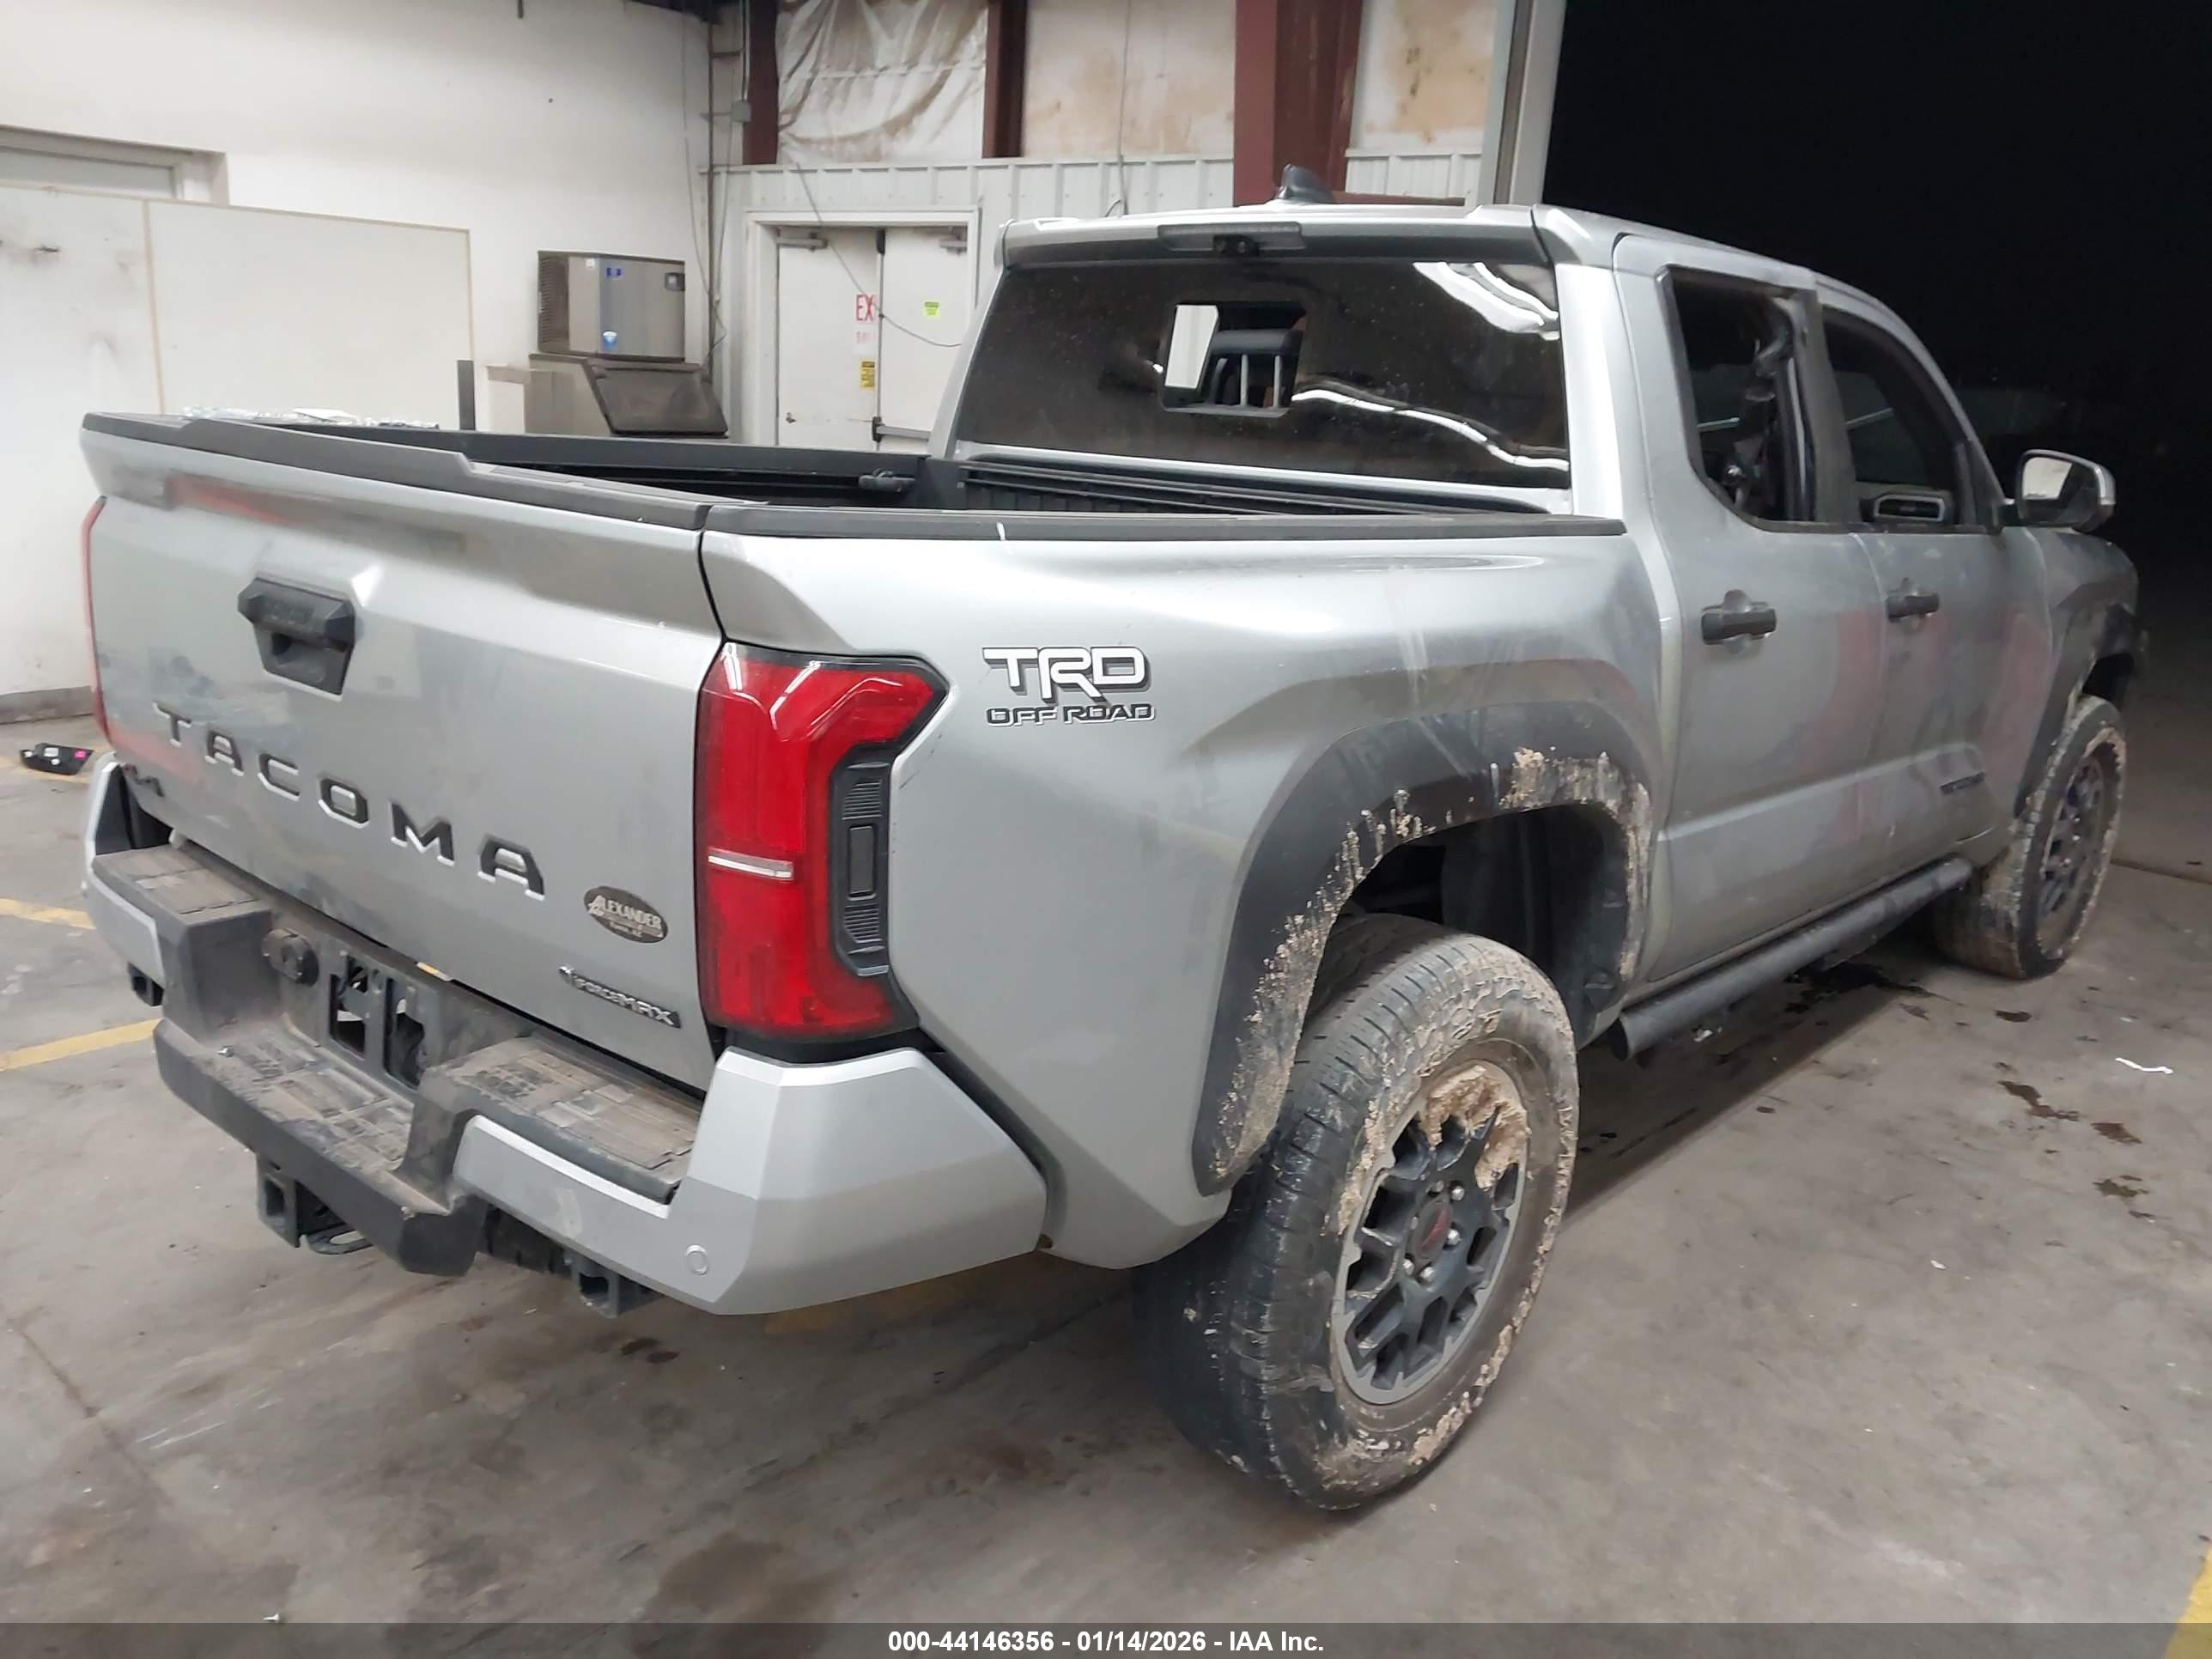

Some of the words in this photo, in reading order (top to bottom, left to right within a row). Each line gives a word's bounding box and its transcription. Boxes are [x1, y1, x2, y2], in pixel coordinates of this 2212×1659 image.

[982, 646, 1151, 707] TRD
[987, 706, 1058, 726] OFF
[1063, 703, 1156, 725] ROAD
[153, 701, 546, 901] TACOMA
[587, 894, 662, 931] ALEXANDER
